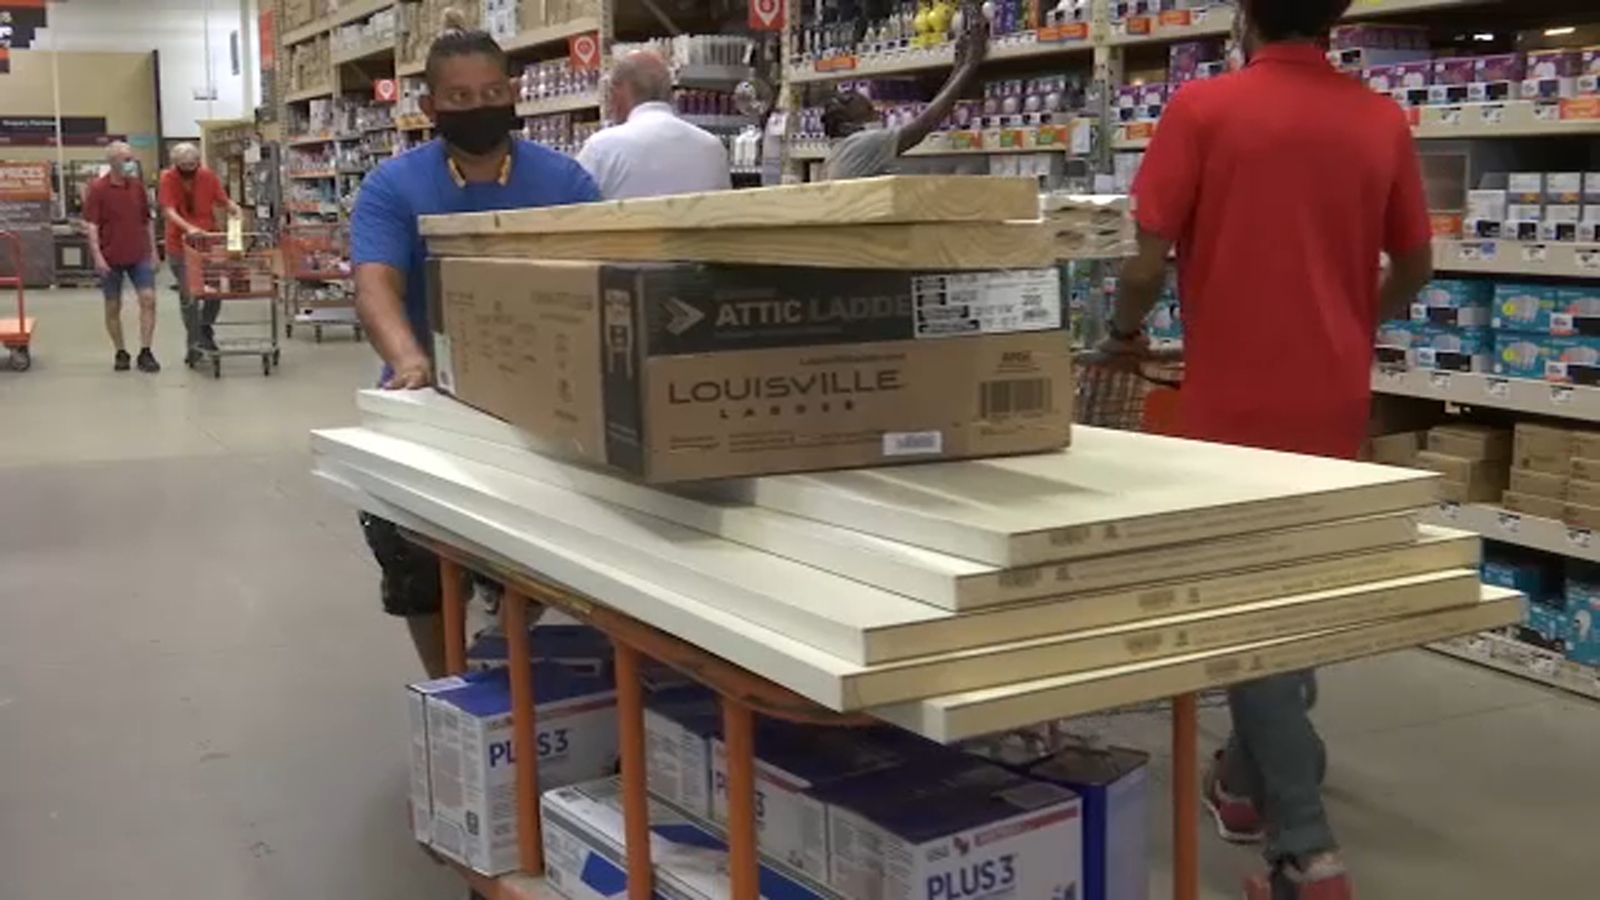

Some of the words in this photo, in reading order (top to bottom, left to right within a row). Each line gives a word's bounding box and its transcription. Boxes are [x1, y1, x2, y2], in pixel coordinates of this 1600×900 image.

[715, 301, 801, 327] ATTIC
[807, 295, 912, 323] LADDE
[668, 369, 906, 405] LOUISVILLE
[488, 731, 552, 768] PLS
[554, 728, 569, 753] 3
[926, 859, 997, 900] PLUS
[998, 853, 1015, 884] 3
